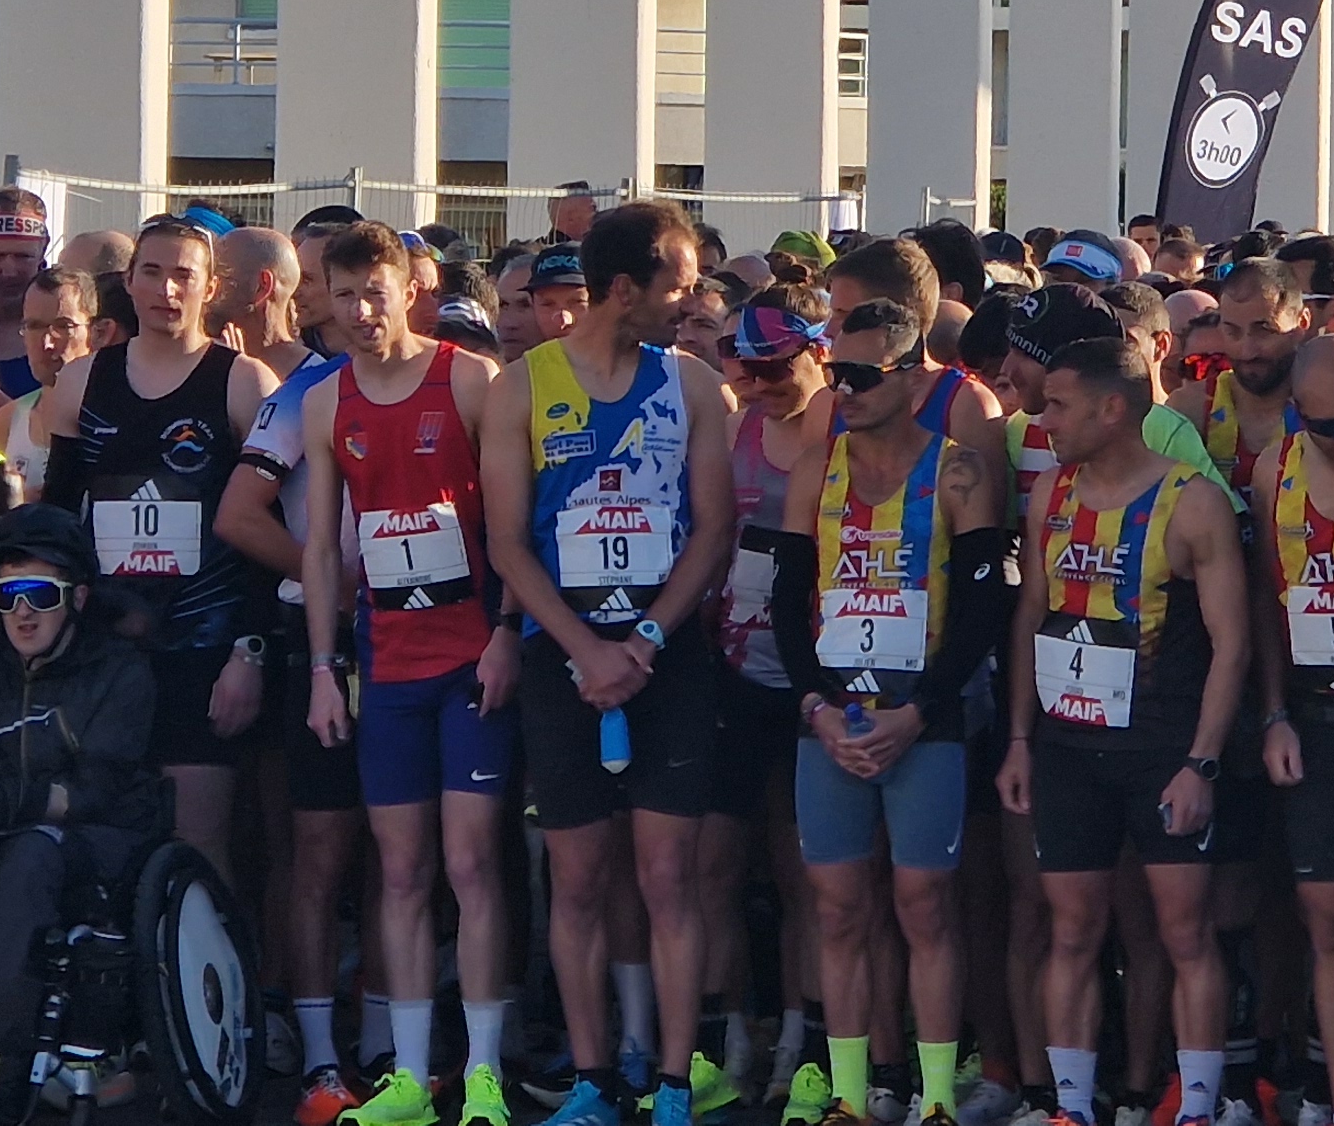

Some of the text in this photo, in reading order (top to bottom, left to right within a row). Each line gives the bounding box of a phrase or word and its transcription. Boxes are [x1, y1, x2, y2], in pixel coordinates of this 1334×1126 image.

[1210, 0, 1307, 59] SAS
[1195, 138, 1243, 168] 3h00
[616, 494, 652, 508] Alpes
[131, 503, 159, 537] 10
[383, 513, 436, 534] MAIF
[589, 511, 648, 531] MAIF
[123, 554, 177, 573] MAIF
[400, 538, 414, 571] 1
[598, 535, 630, 570] 19
[846, 594, 906, 613] MAIF
[860, 618, 875, 654] 3
[1068, 646, 1084, 681] 4
[1055, 698, 1105, 722] MAIF
